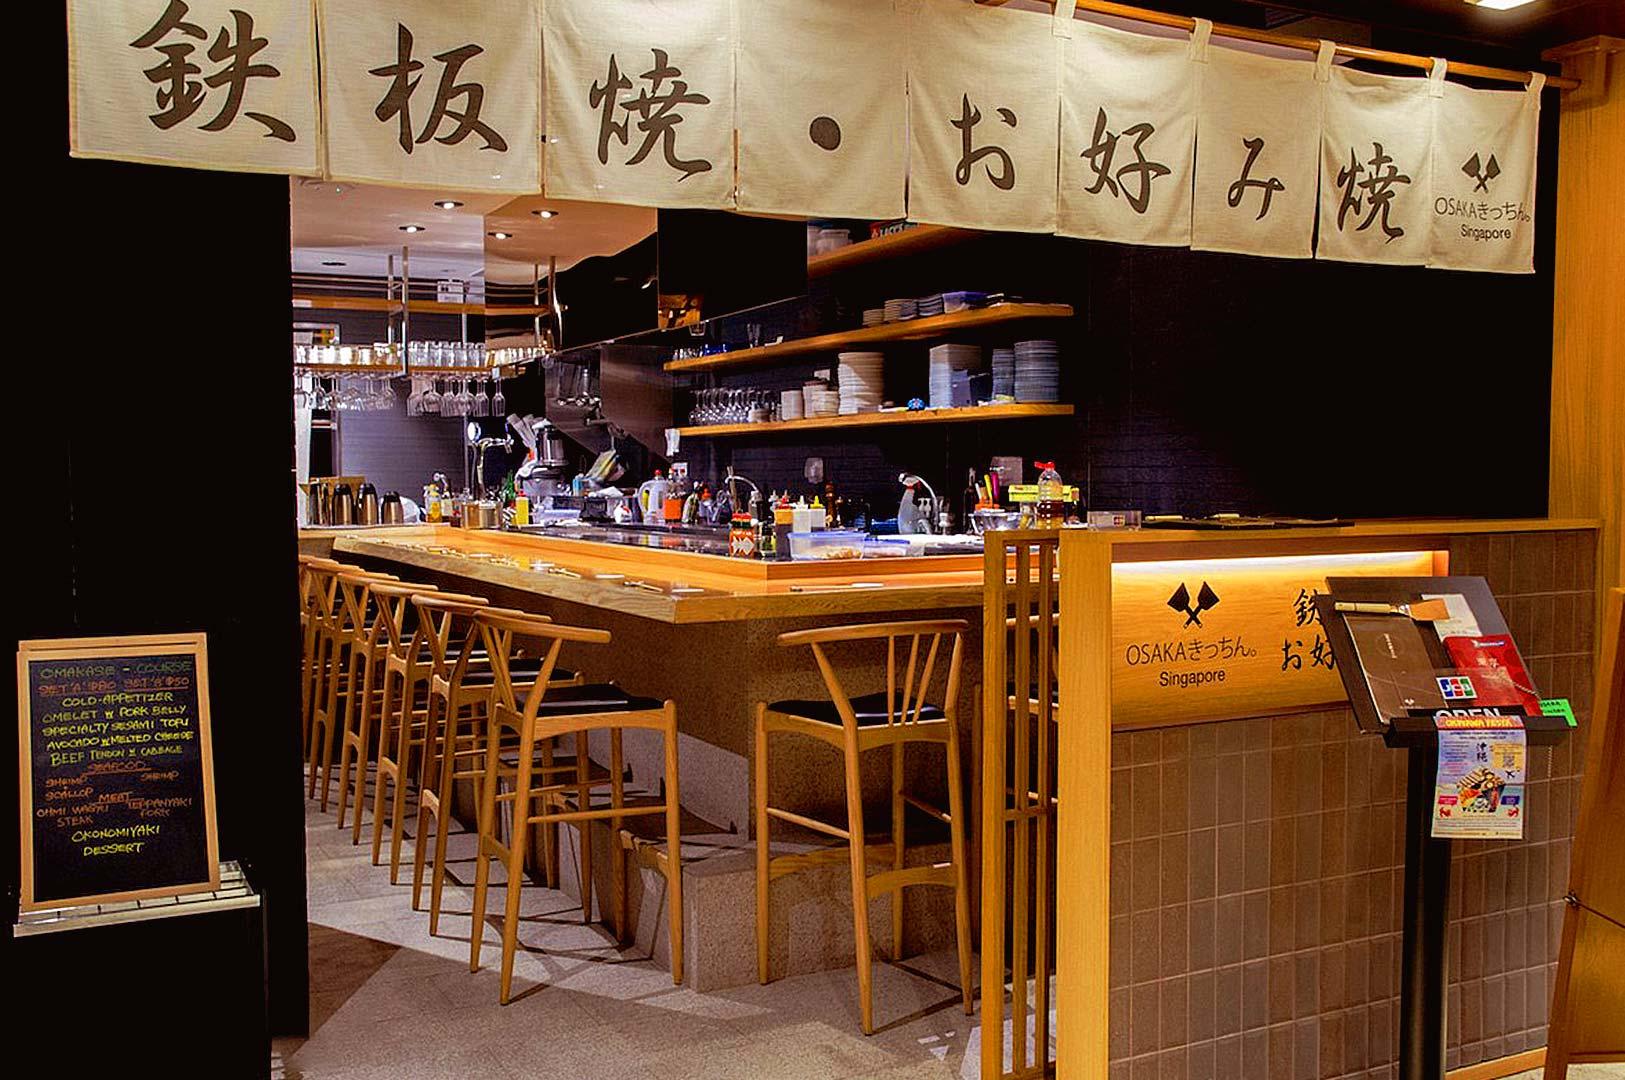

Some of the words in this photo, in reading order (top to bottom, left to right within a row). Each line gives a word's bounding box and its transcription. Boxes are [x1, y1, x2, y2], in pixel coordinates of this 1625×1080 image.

[1460, 223, 1512, 242] Singapore
[1159, 668, 1225, 688] Singapore
[120, 707, 148, 717] PORK
[151, 705, 186, 715] BELLY
[160, 718, 189, 728] TOFU
[47, 738, 99, 750] AVOCADO
[111, 734, 151, 745] MELTED
[51, 752, 85, 767] BEEF
[72, 825, 160, 842] OKONOMIYAKI
[84, 842, 144, 856] DESSERT
